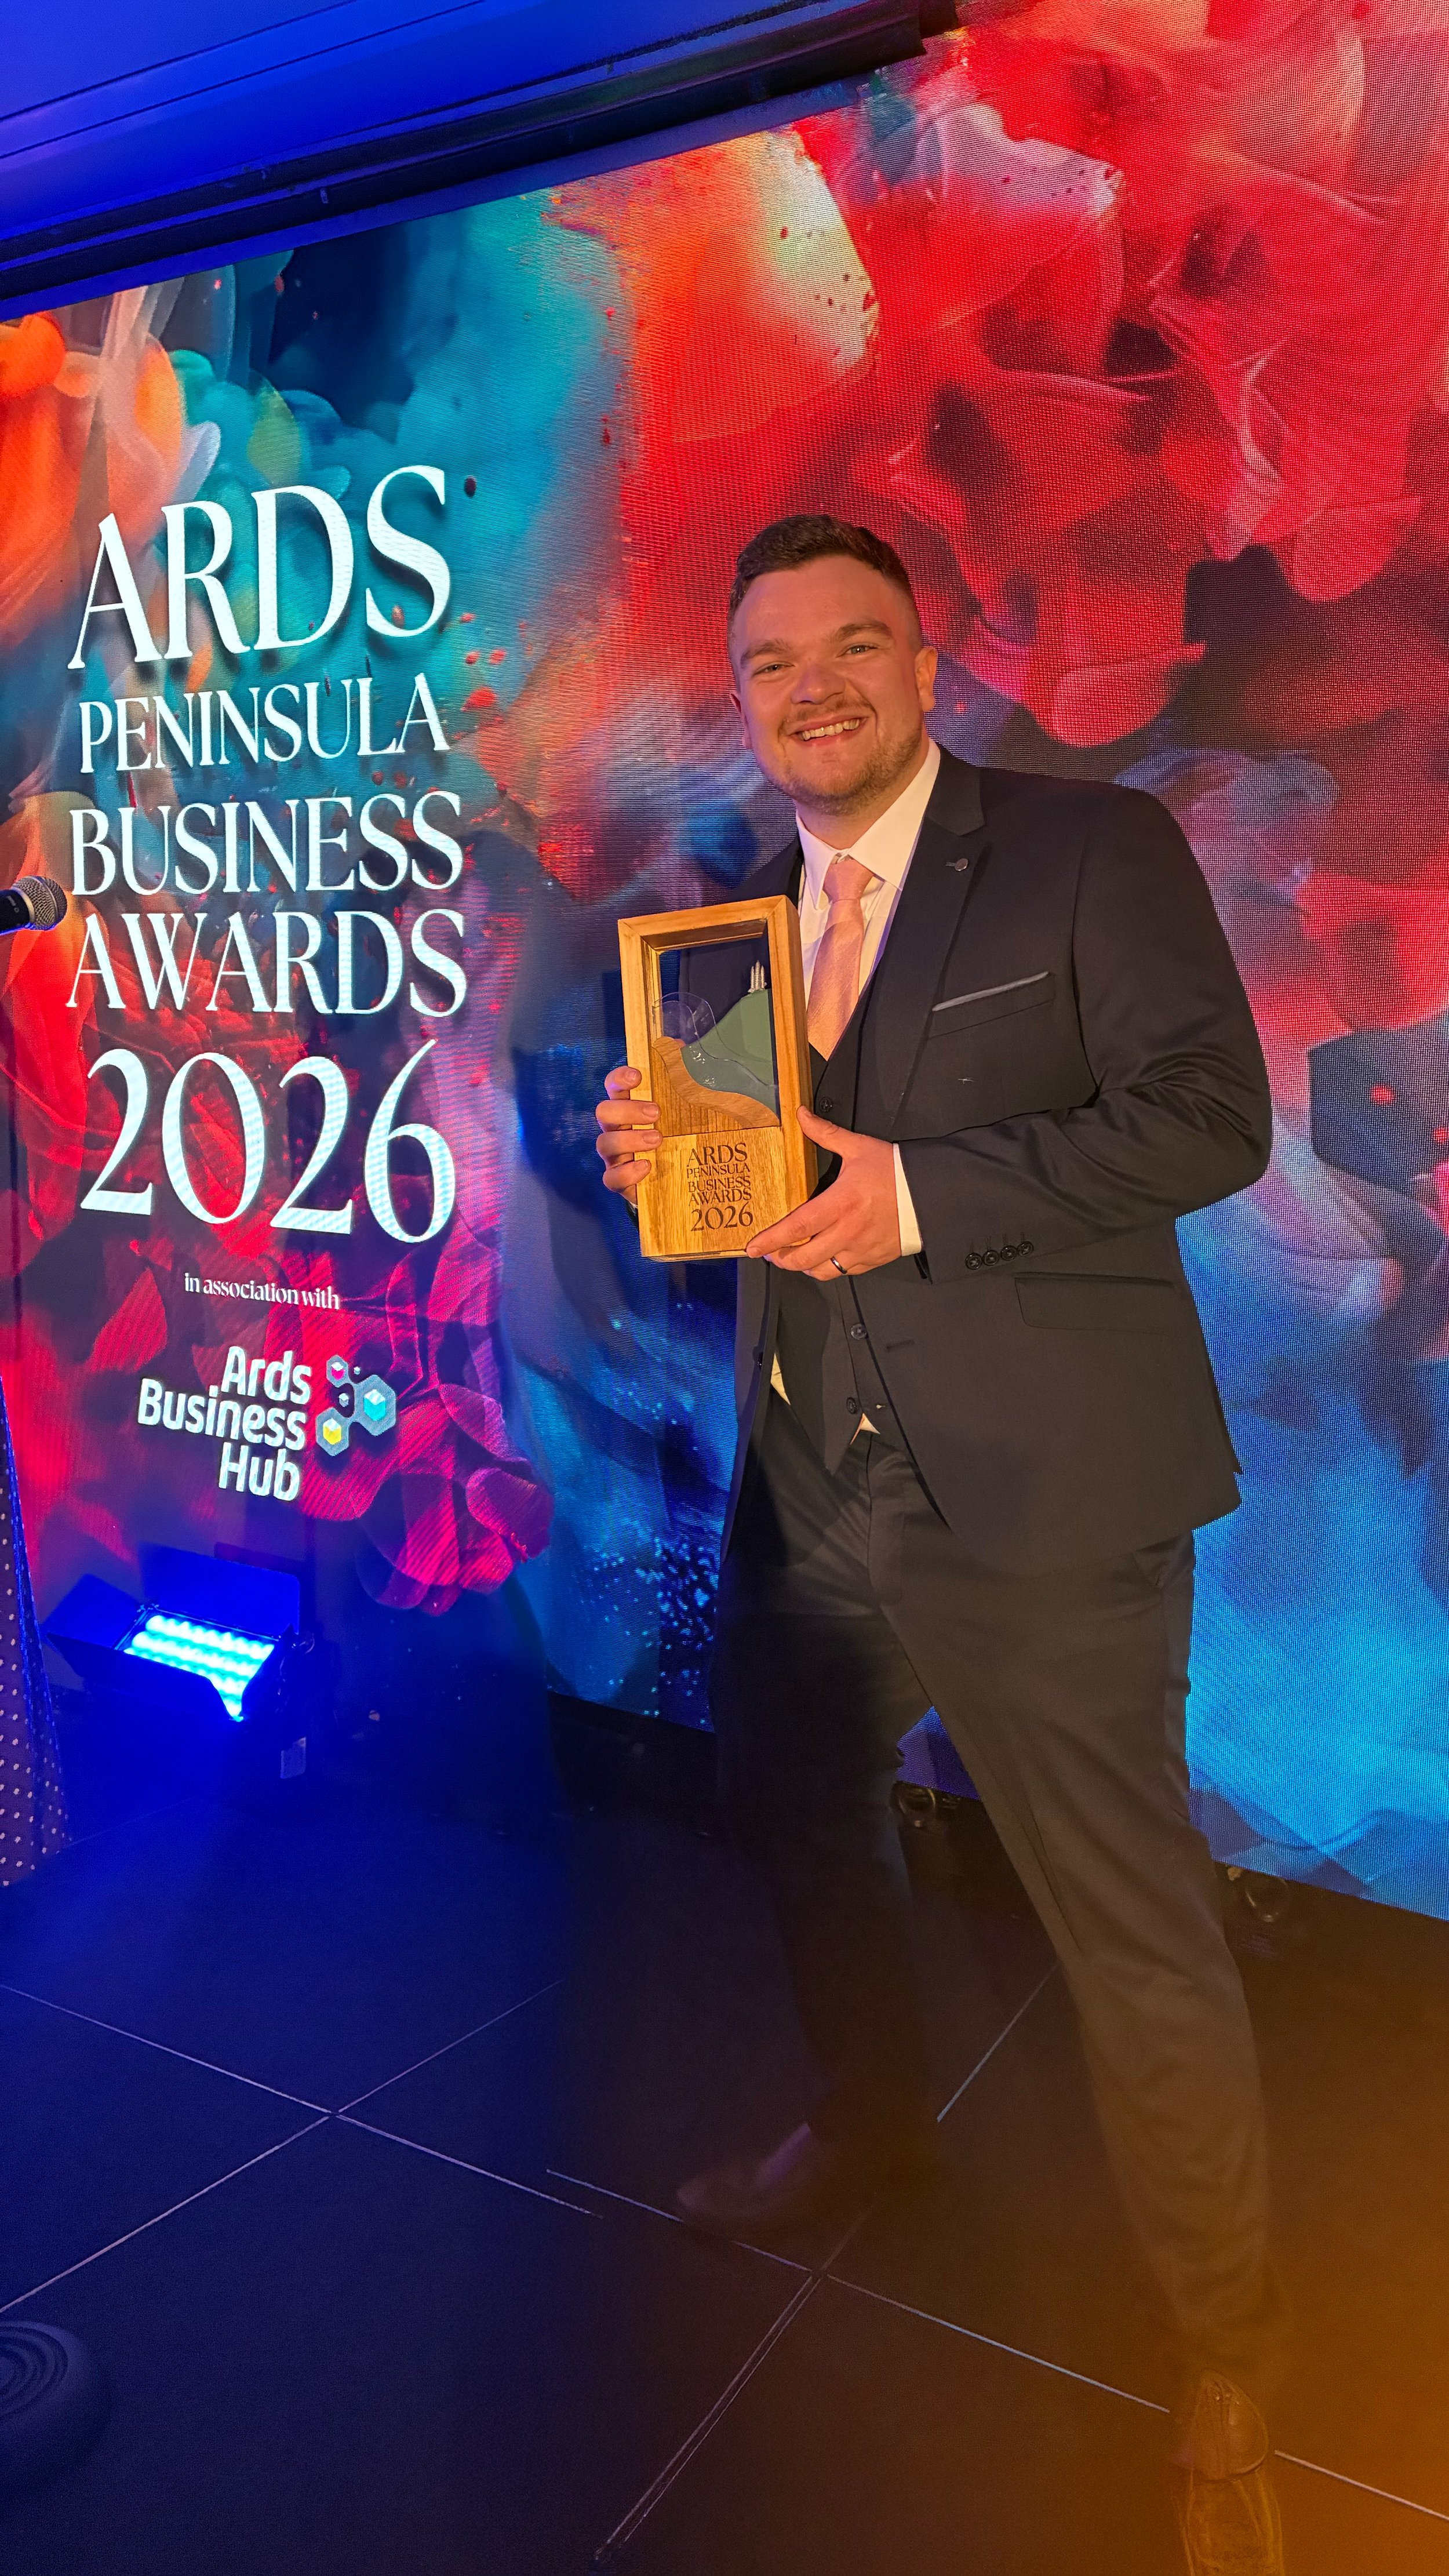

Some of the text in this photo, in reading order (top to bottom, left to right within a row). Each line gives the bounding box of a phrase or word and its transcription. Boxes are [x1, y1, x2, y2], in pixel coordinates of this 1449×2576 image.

[68, 466, 451, 670] ARDS
[79, 672, 450, 773] PENINSULA
[70, 790, 463, 896] BUSINESS
[66, 909, 467, 1016] AWARDS
[81, 1039, 456, 1243] 2026
[687, 1142, 748, 1167] ARDS
[687, 1163, 751, 1178] PENINSULA
[688, 1176, 751, 1193] BUSINESS
[689, 1187, 752, 1206] AWARDS
[691, 1201, 753, 1232] 2026
[185, 1272, 340, 1310] in association with
[221, 1346, 311, 1405] Ards
[138, 1378, 307, 1450] Business
[219, 1442, 300, 1501] Hub
